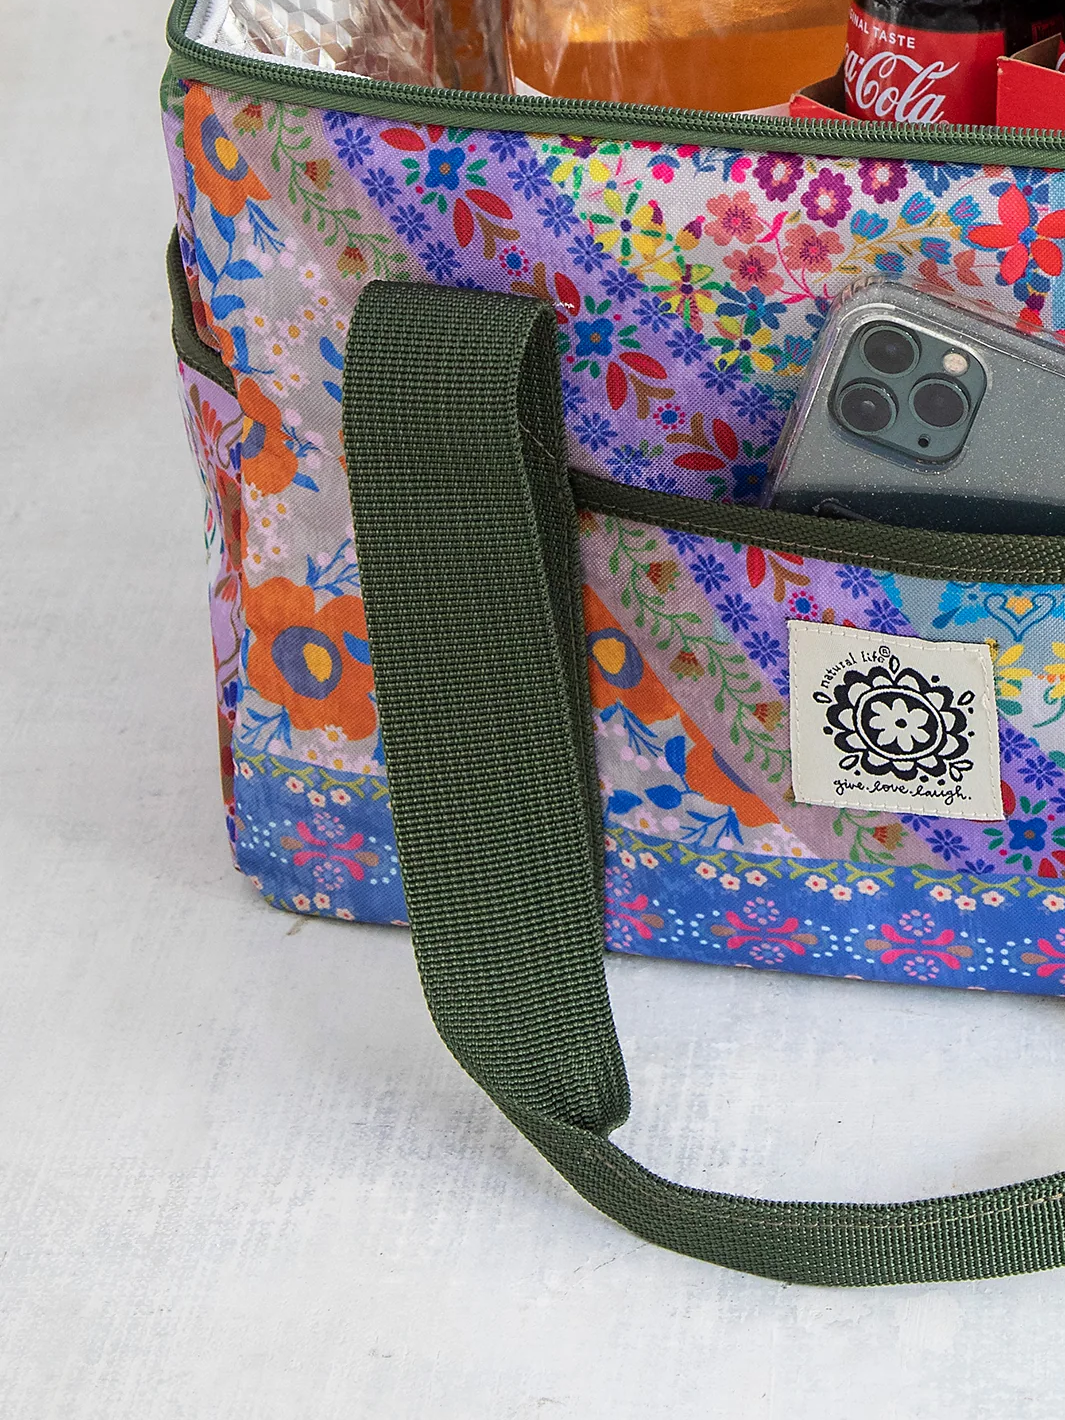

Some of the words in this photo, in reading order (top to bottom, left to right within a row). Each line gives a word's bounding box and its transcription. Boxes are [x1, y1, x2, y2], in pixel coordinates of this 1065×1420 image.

[873, 25, 915, 49] TASTE
[844, 42, 960, 126] a-Cola
[820, 651, 857, 689] natural
